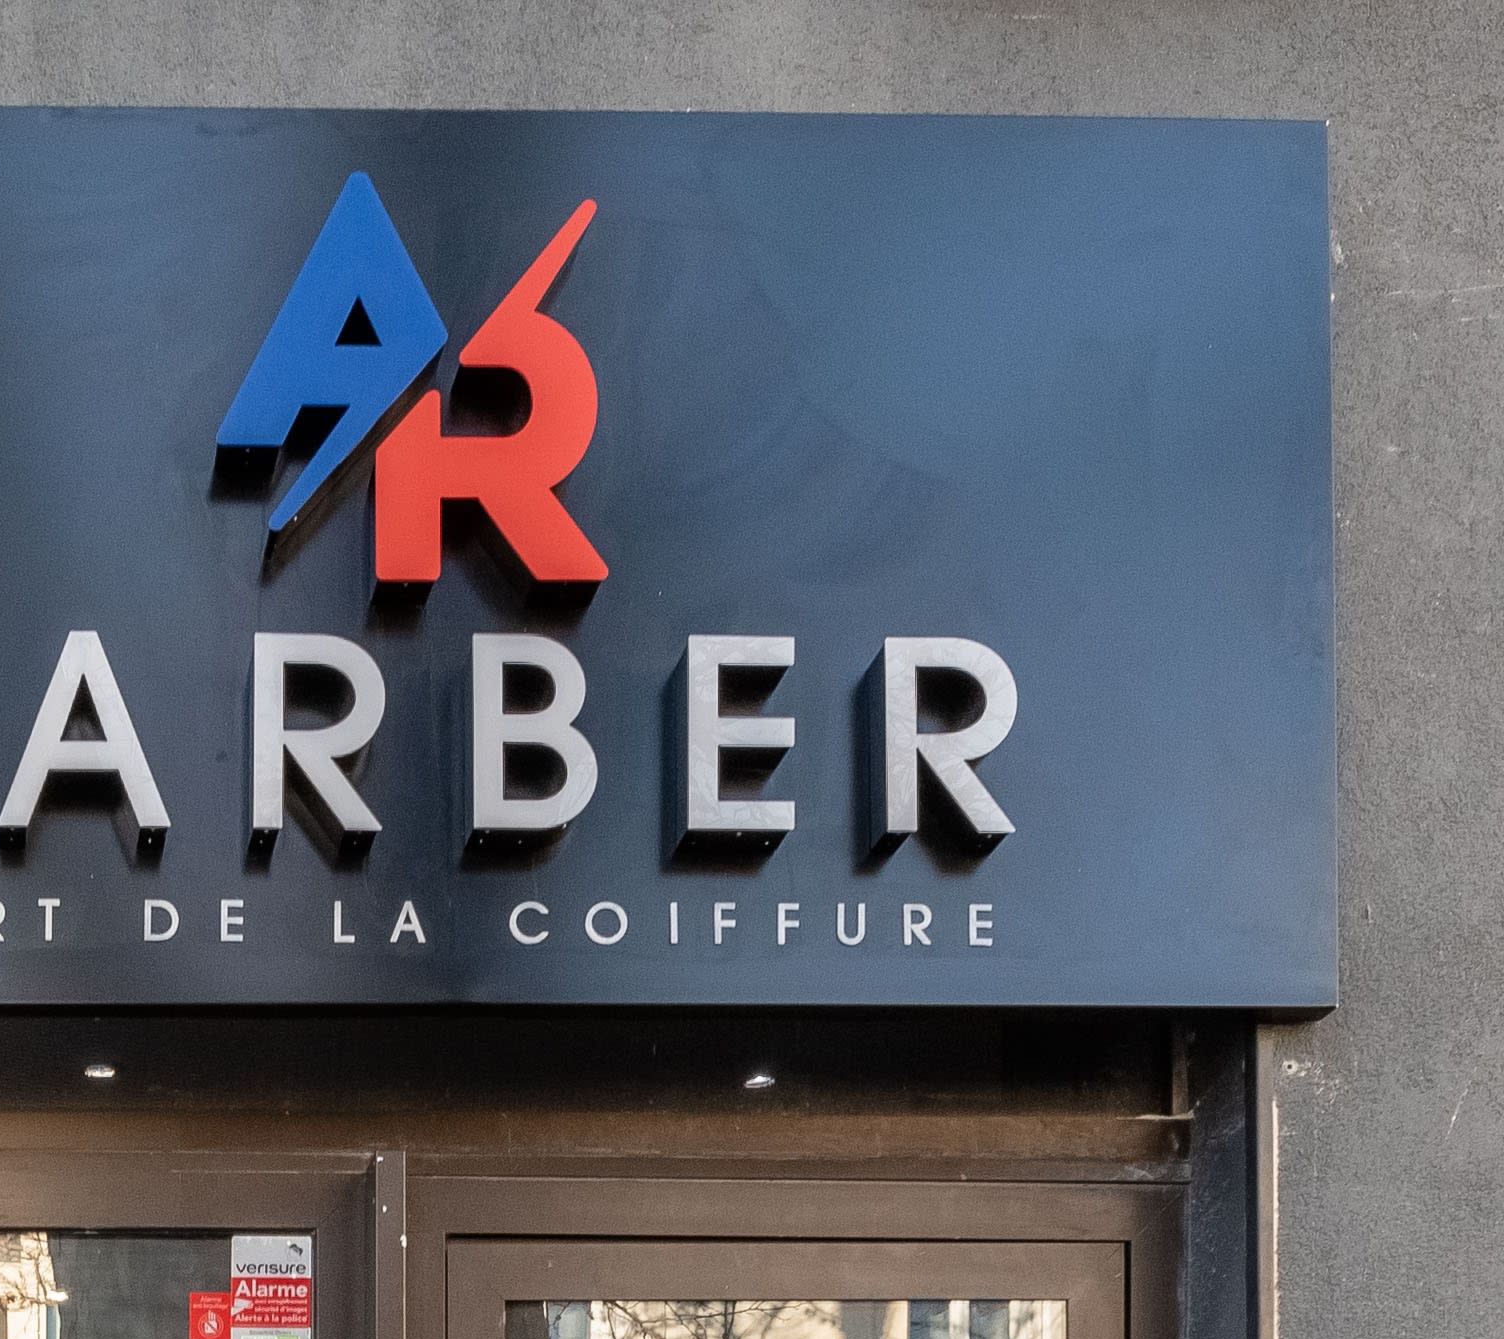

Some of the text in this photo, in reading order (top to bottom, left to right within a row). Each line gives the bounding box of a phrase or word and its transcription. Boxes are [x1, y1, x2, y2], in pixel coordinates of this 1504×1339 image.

[144, 900, 243, 941] DE
[334, 901, 425, 943] LA
[510, 902, 993, 946] COIFFURE
[236, 1263, 307, 1274] verisure
[235, 1279, 308, 1298] Alarme
